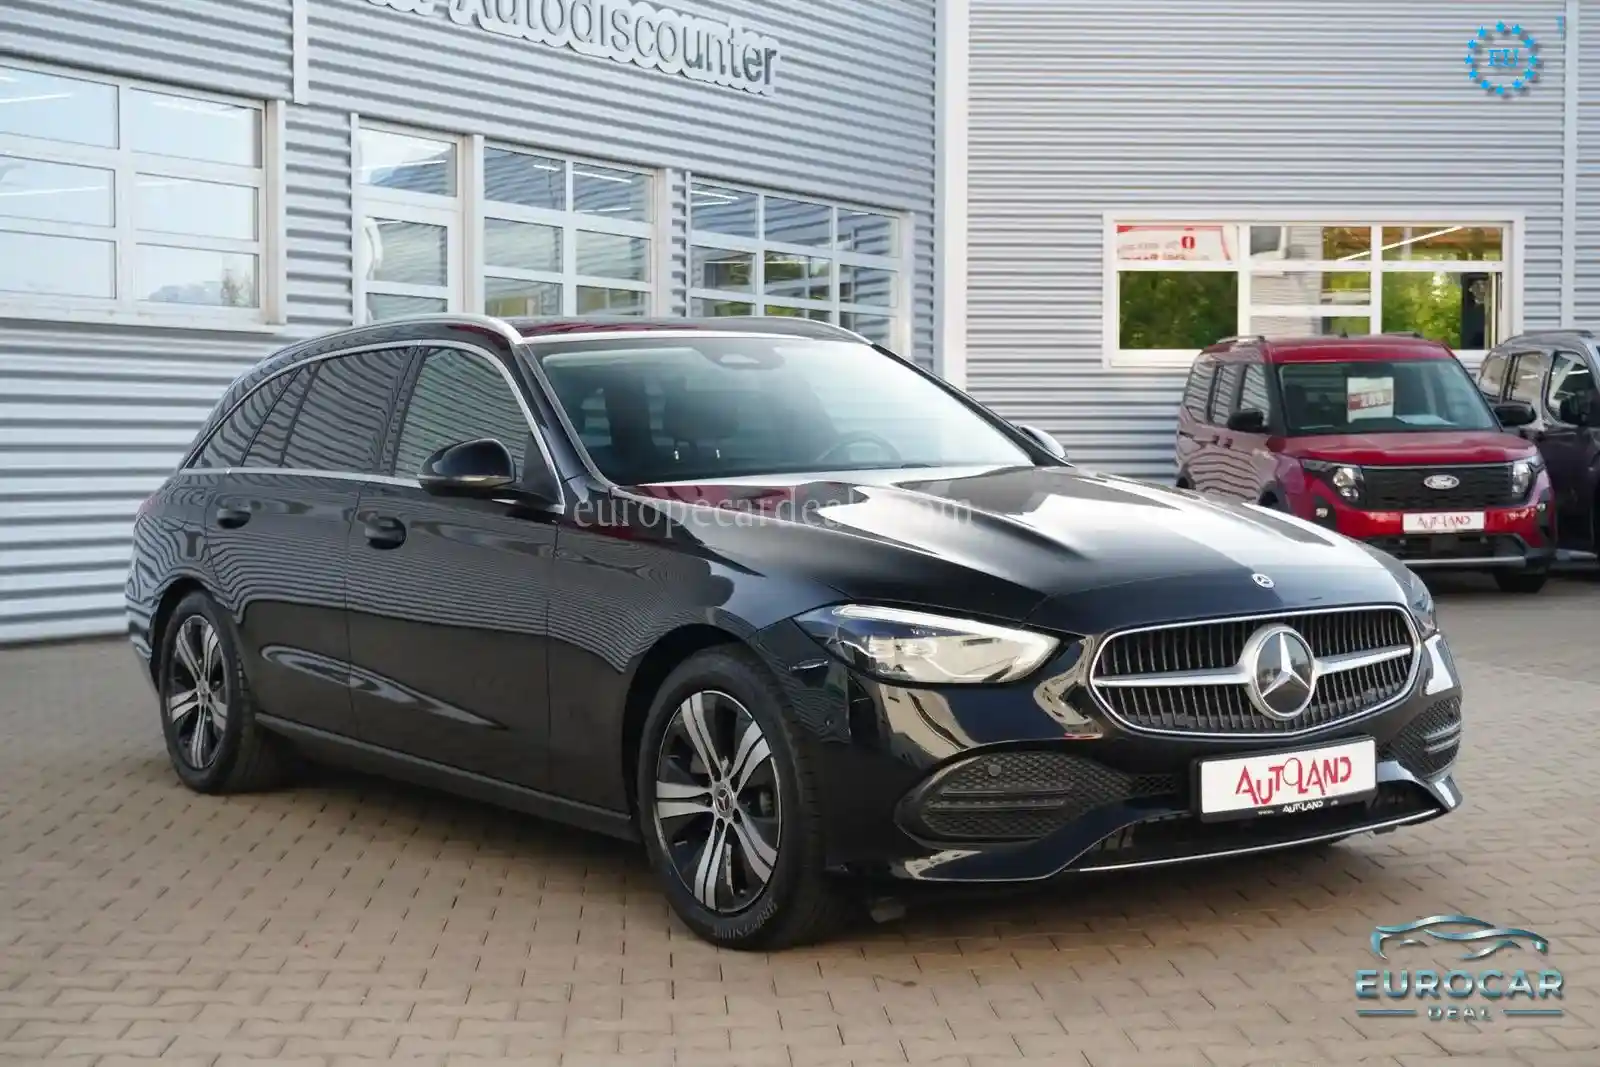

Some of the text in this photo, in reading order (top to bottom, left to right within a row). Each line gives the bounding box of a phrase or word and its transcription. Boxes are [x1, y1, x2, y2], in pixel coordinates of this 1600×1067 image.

[455, 0, 778, 86] utodiscounter
[1417, 515, 1472, 530] AUTLAND
[1235, 755, 1353, 805] AUTOLAND
